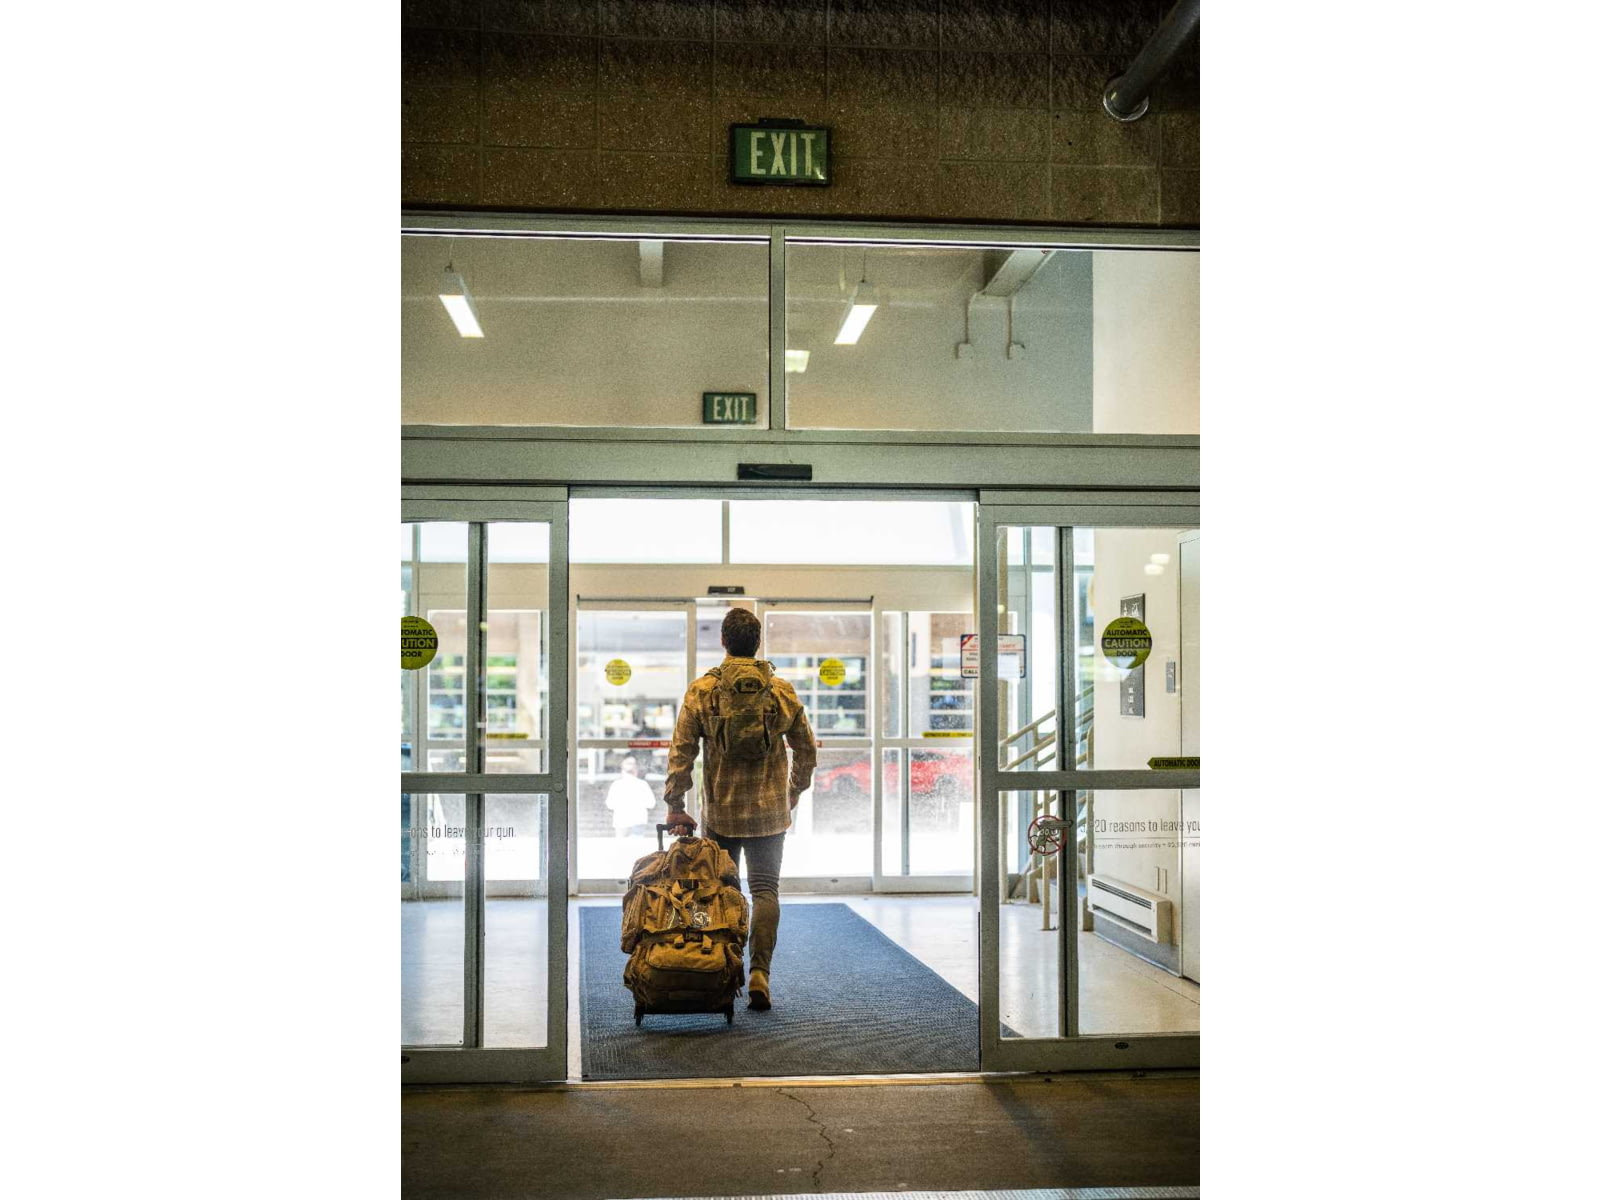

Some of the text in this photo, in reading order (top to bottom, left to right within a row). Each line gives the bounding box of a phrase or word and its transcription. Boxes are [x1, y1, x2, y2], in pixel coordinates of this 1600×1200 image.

[750, 131, 816, 176] EXIT
[713, 396, 749, 421] EXIT
[1104, 638, 1149, 649] CAUTION
[431, 825, 441, 839] to
[444, 825, 468, 838] leav
[1109, 821, 1146, 832] reasons
[1148, 819, 1158, 832] to
